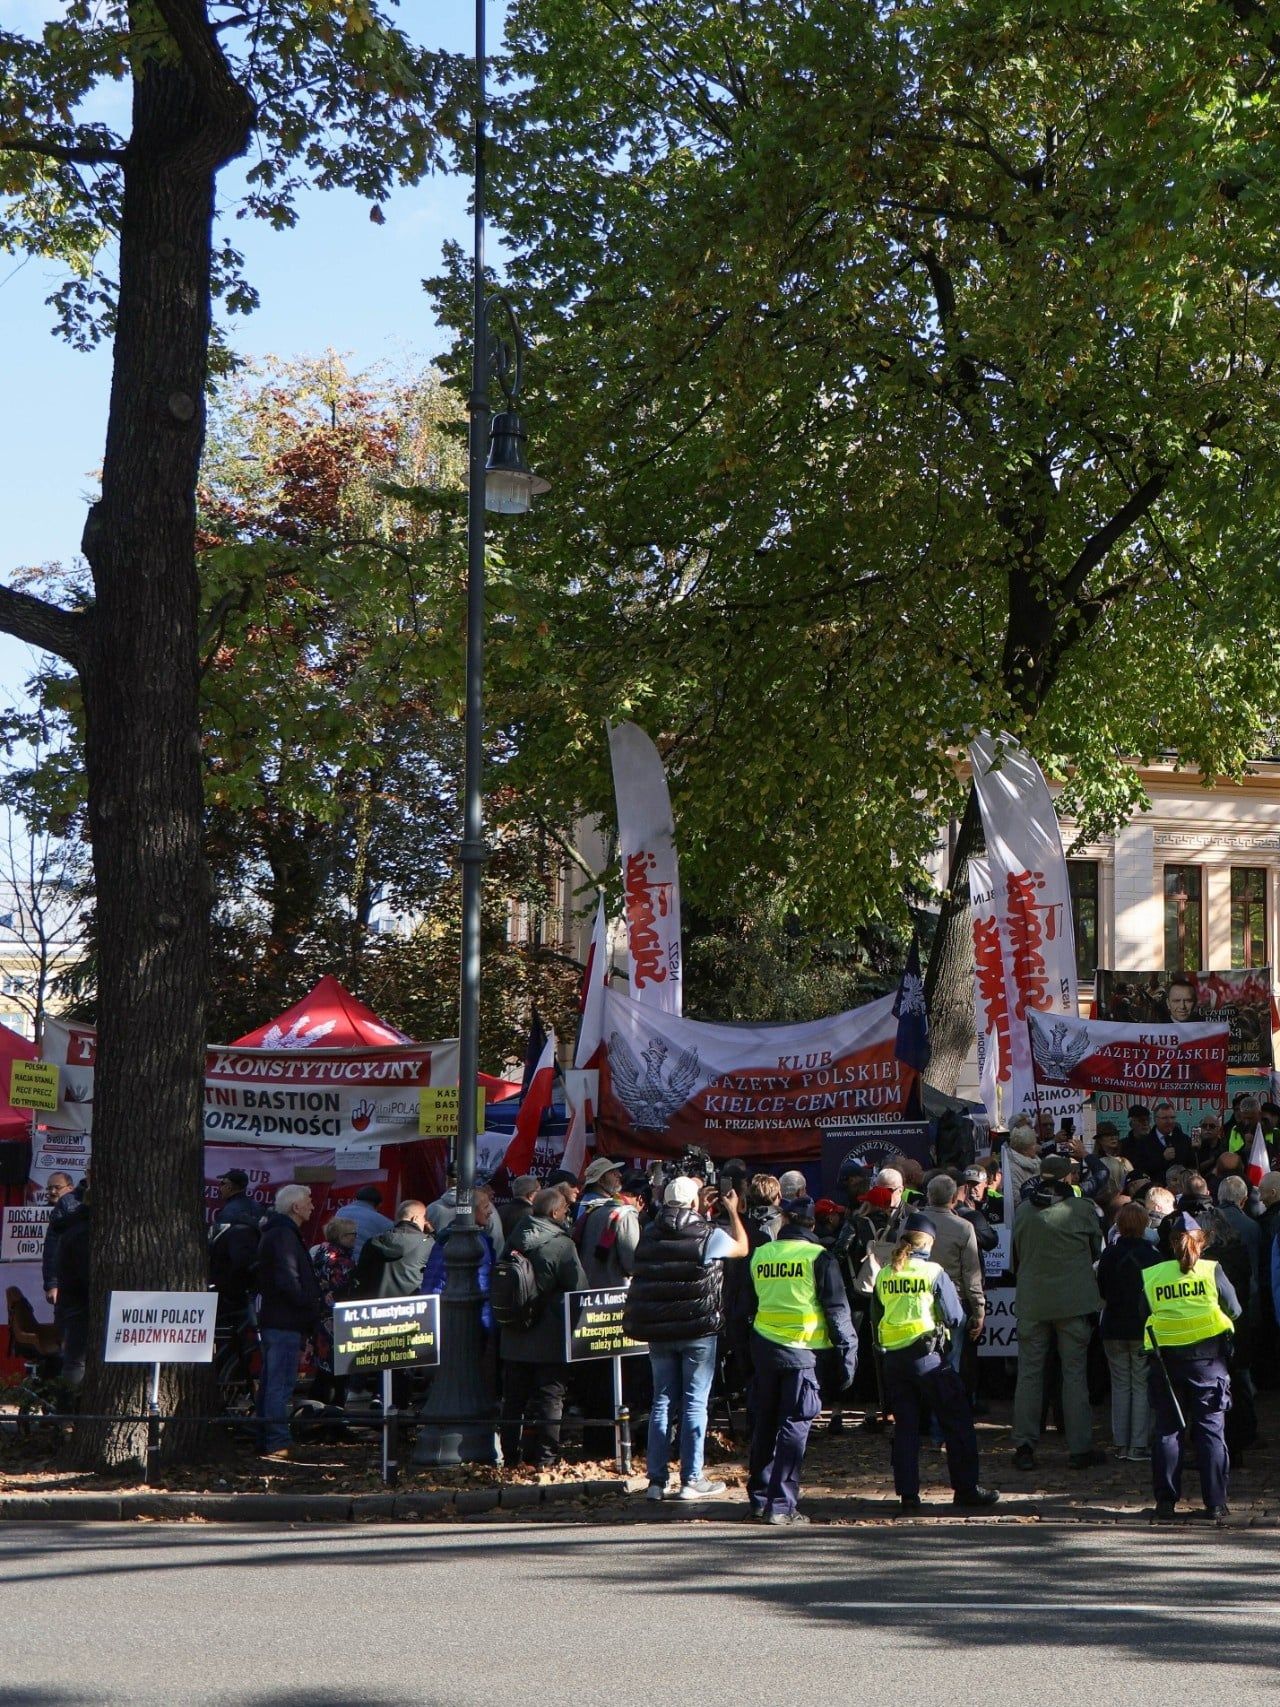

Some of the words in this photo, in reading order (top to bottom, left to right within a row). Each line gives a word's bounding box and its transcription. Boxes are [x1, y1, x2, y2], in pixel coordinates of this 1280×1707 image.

[1139, 1034, 1179, 1047] KLUB
[778, 1051, 833, 1072] KLUB
[1093, 1046, 1150, 1061] GAZETY
[1156, 1047, 1226, 1062] POLSKIEJ
[212, 1053, 422, 1081] KONSTYTUCYJNY
[1123, 1060, 1173, 1081] ŁÓDŹ
[708, 1074, 791, 1093] GAZETY
[802, 1059, 902, 1088] POLSKIEJ
[242, 1089, 342, 1114] BASTION
[703, 1085, 902, 1114] KIELCE-CENTRUM
[703, 1116, 722, 1130] IM.
[725, 1114, 811, 1131] PRZEMYSŁAWA
[9, 1207, 33, 1222] DOŚĆ
[12, 1223, 44, 1238] PRAWA
[757, 1261, 805, 1280] POLICJA
[882, 1278, 927, 1295] POLICJA
[1156, 1281, 1207, 1302] POLICJA
[122, 1308, 158, 1324] WOLNI
[162, 1308, 205, 1324] POLACY
[344, 1308, 360, 1323] Art.
[361, 1307, 370, 1321] 4.
[371, 1303, 415, 1320] Konstytucji
[587, 1311, 611, 1324] Władza
[115, 1326, 208, 1345] #BĄDŹMYRAZEM
[351, 1325, 379, 1339] Władza
[574, 1329, 581, 1339] w
[337, 1344, 346, 1354] w
[346, 1336, 405, 1353] Rzeczypospolitej
[406, 1331, 434, 1346] Polskiej
[590, 1339, 612, 1351] należy
[612, 1337, 621, 1348] do
[356, 1354, 380, 1367] należy
[380, 1352, 389, 1363] do
